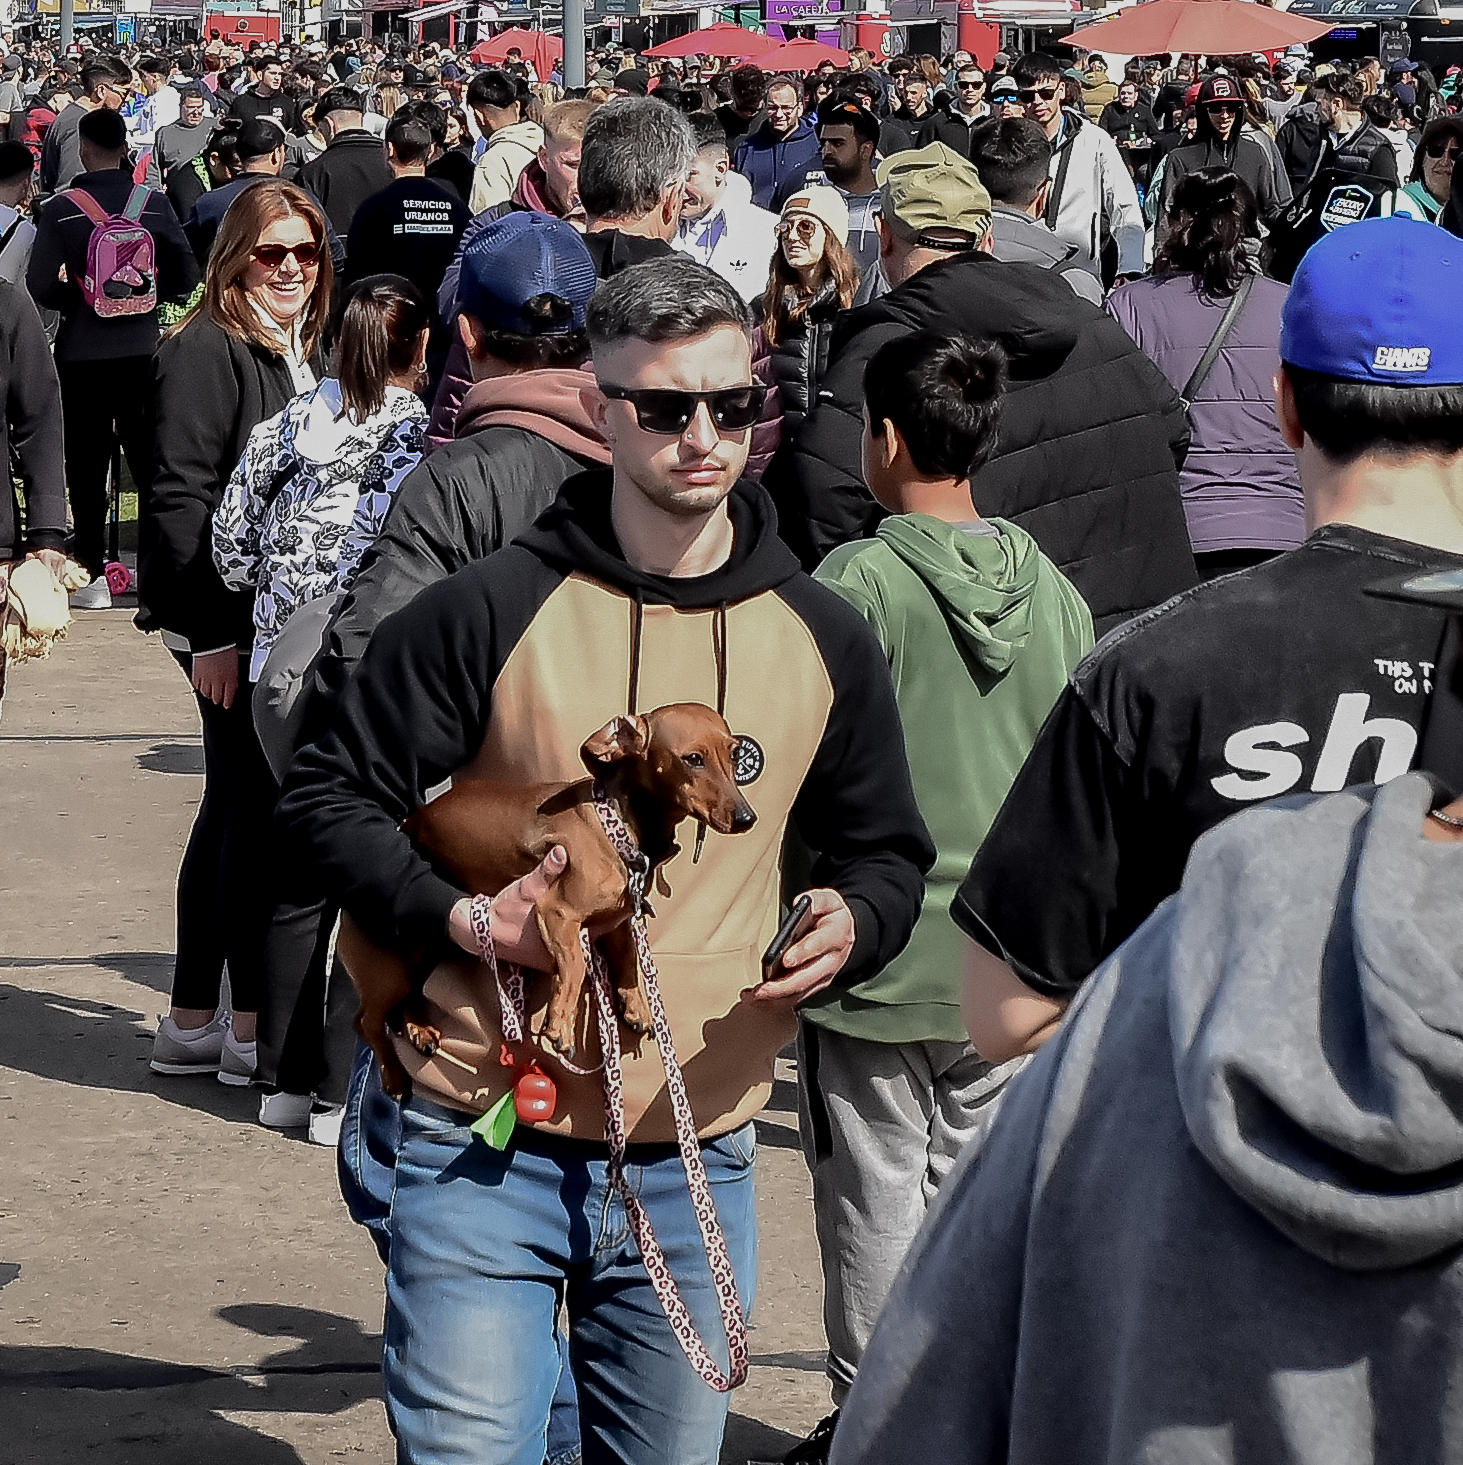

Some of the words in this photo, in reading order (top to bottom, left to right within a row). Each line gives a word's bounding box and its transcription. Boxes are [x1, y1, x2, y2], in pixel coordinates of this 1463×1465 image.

[402, 199, 452, 210] SERVICIOS
[404, 211, 450, 221] URBANOS
[1375, 346, 1431, 368] GIANTS
[1373, 658, 1413, 678] THIS
[1394, 678, 1417, 694] ON
